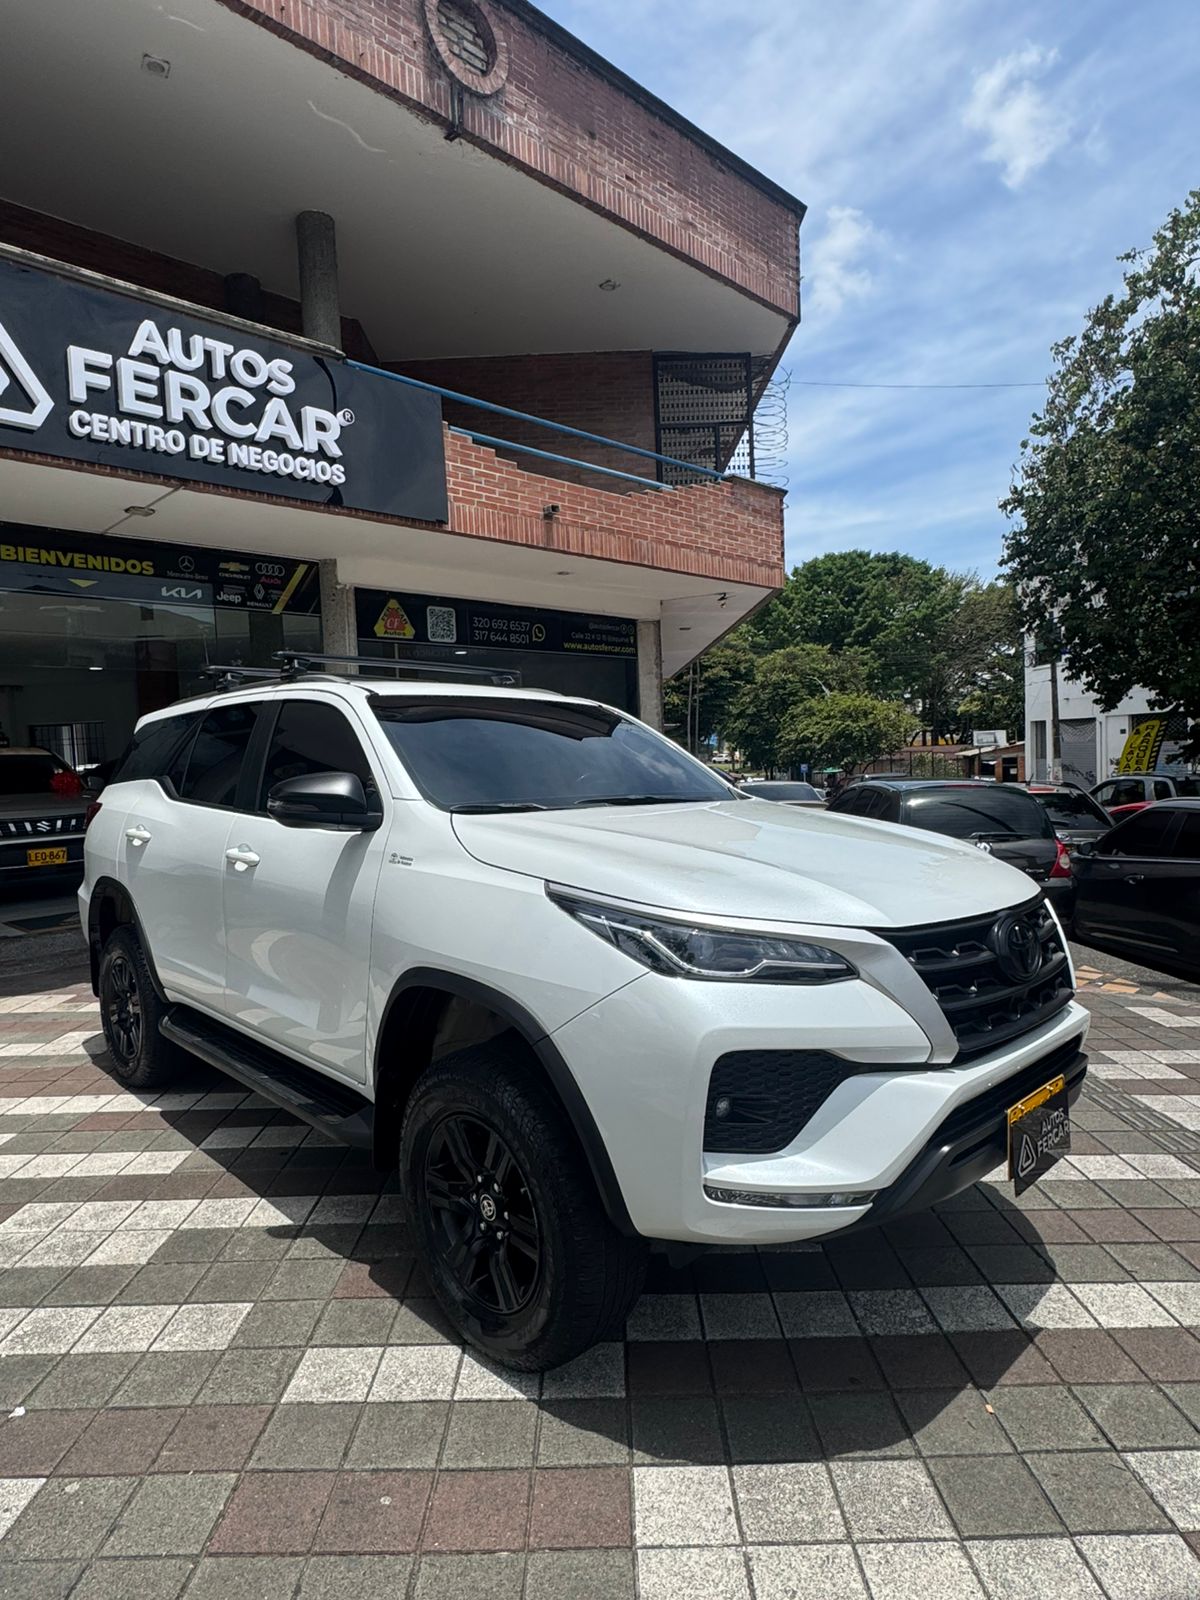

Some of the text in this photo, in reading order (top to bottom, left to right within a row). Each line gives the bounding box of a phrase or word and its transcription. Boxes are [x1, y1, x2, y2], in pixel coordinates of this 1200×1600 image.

[128, 319, 296, 396] AUTOS
[69, 409, 346, 486] CENTRO DE NEGOCIOS
[0, 544, 155, 575] BIENVENIDOS
[216, 591, 242, 604] Jeep
[472, 616, 531, 632] 320 692 6537
[473, 630, 530, 644] 317 644 8501
[563, 641, 636, 654] www.autosfercar.com
[1042, 1108, 1065, 1135] AUTOS
[1037, 1120, 1071, 1158] FERCAR
